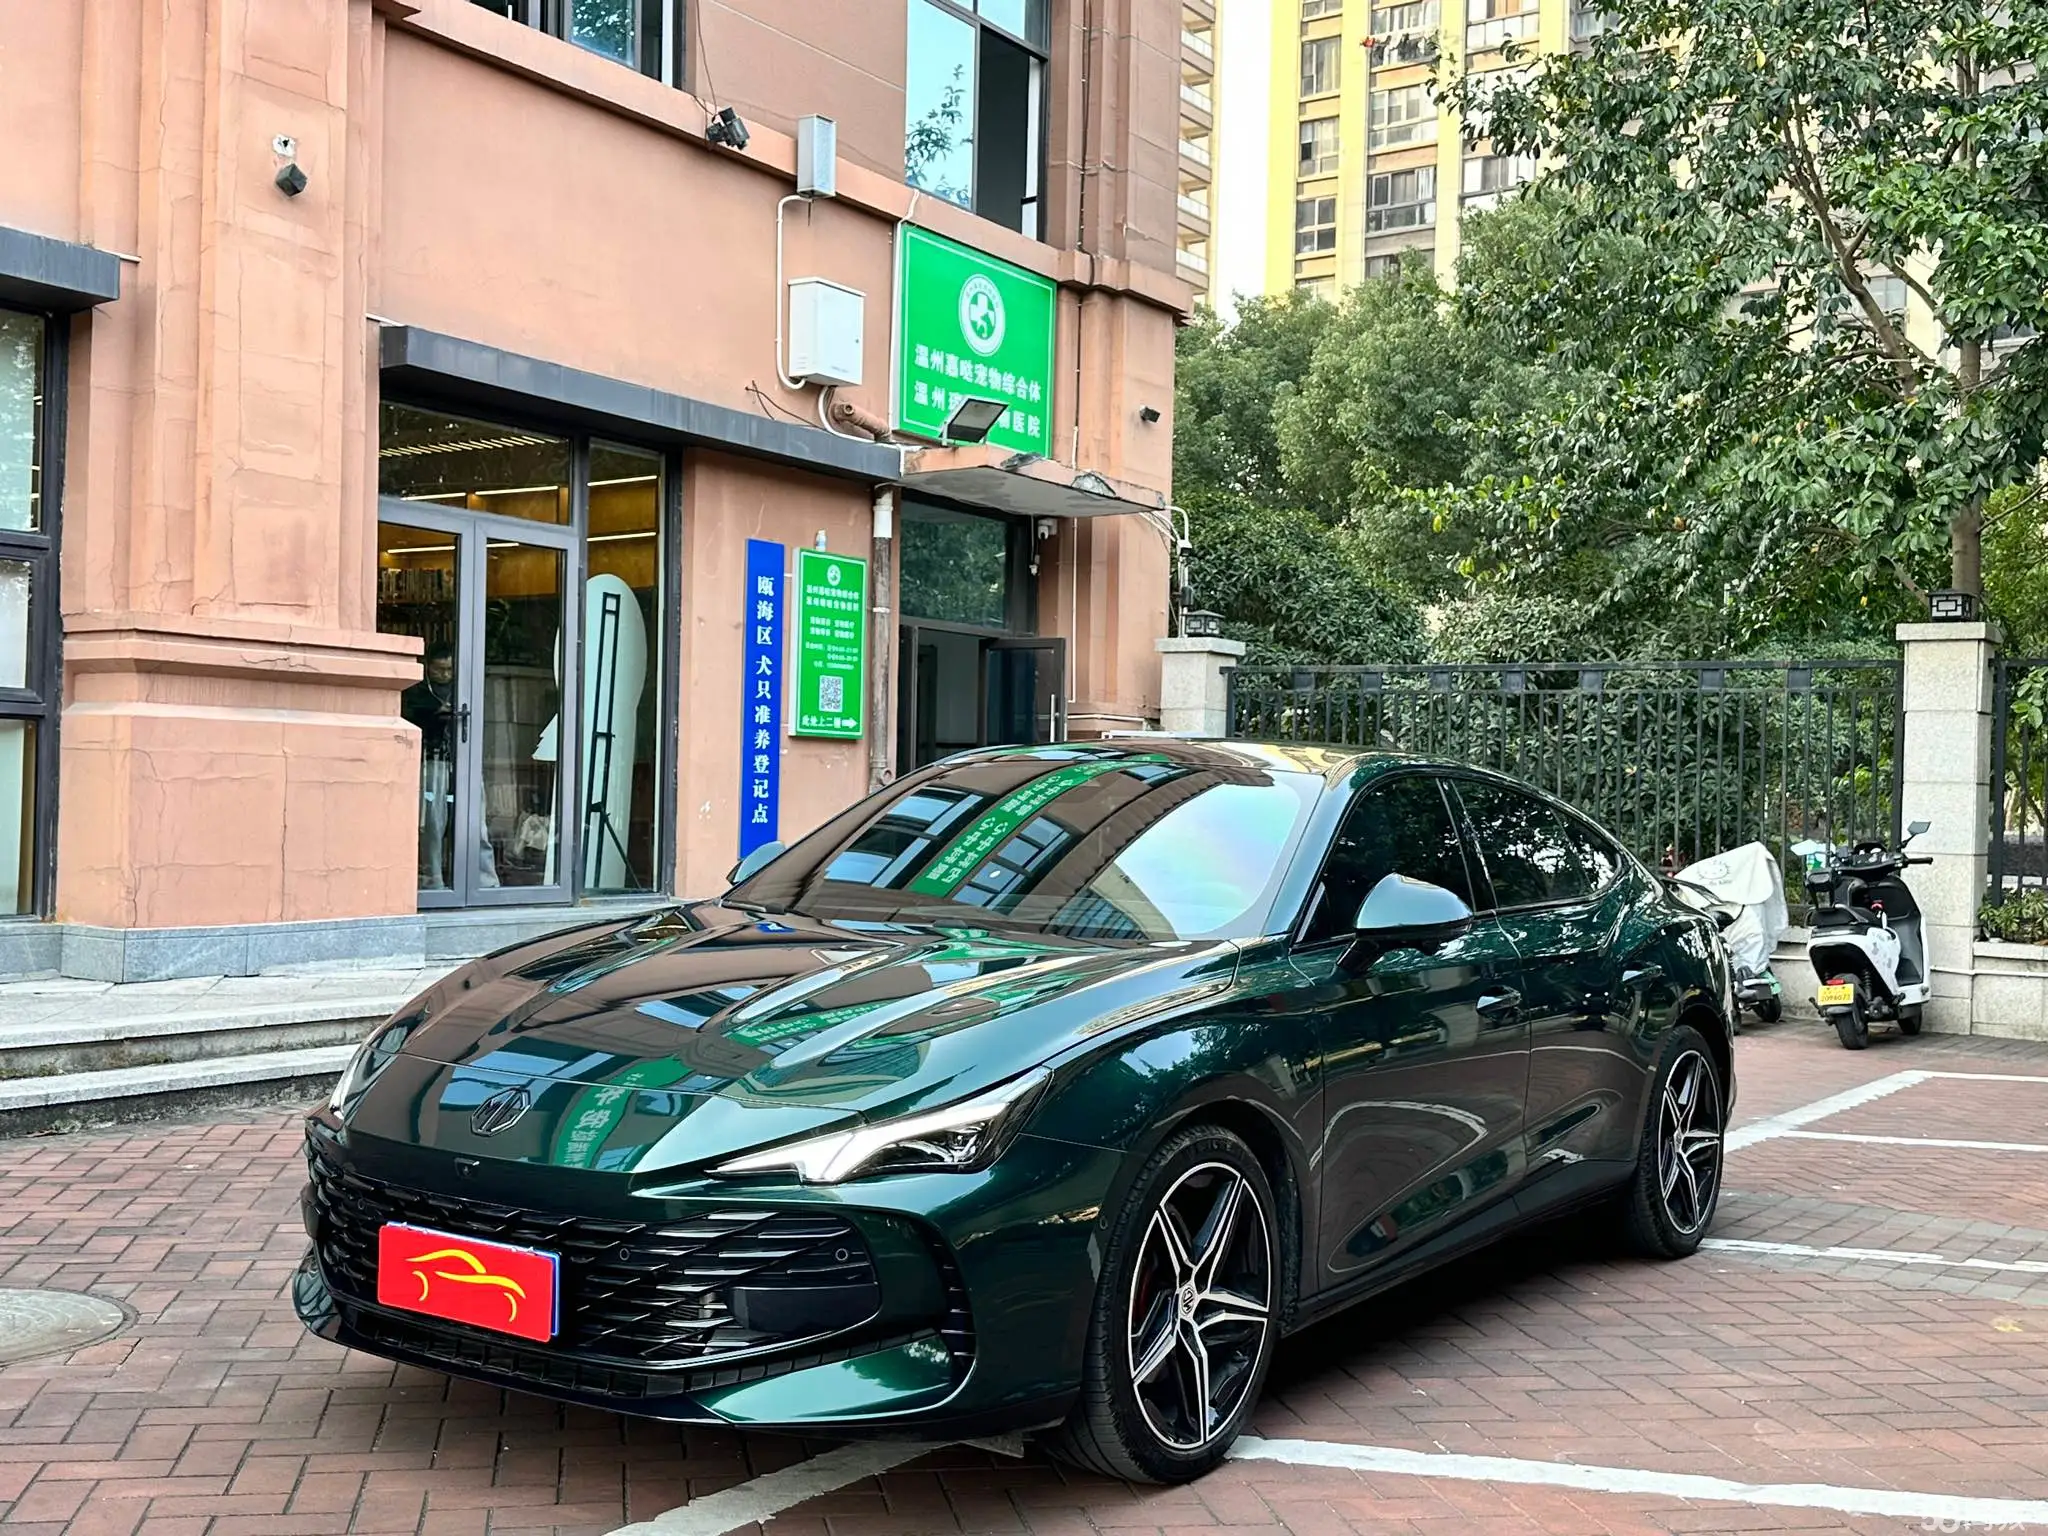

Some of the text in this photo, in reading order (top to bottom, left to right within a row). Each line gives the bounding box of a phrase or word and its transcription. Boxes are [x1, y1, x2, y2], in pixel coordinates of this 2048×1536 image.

[915, 344, 1041, 403] 温州嘉哒宠物综合体
[752, 575, 774, 823] 瓯海区犬只准养登记点
